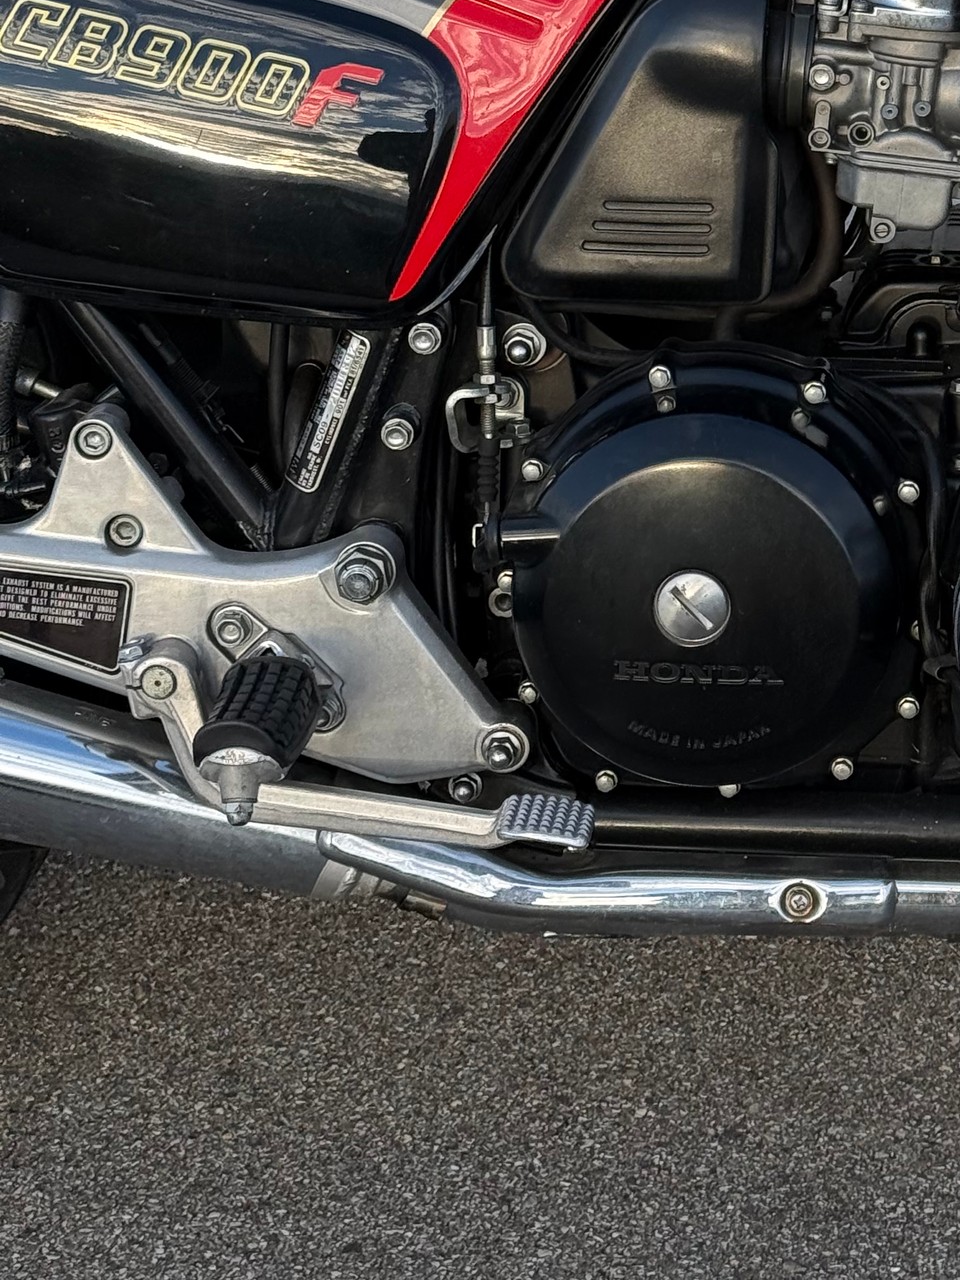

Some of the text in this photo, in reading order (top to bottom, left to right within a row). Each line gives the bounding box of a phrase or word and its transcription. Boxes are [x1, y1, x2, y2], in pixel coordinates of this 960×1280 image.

[2, 577, 119, 598] EXHAUST SYSTEM IS A MANUFACTURED
[6, 586, 38, 596] DESIGNED
[40, 589, 49, 598] TO
[50, 591, 83, 602] ELIMINATE
[85, 595, 118, 606] EXCESSIVE
[0, 593, 117, 614] GIVE THE BEST PERFORMANCE UNDER
[30, 605, 77, 618] MODIFICATIONS
[77, 610, 92, 620] WILL
[93, 612, 116, 622] AFFECT
[8, 611, 38, 621] DECREASE
[612, 659, 785, 686] HONDA
[627, 720, 773, 750] MADE IN JAPAN
